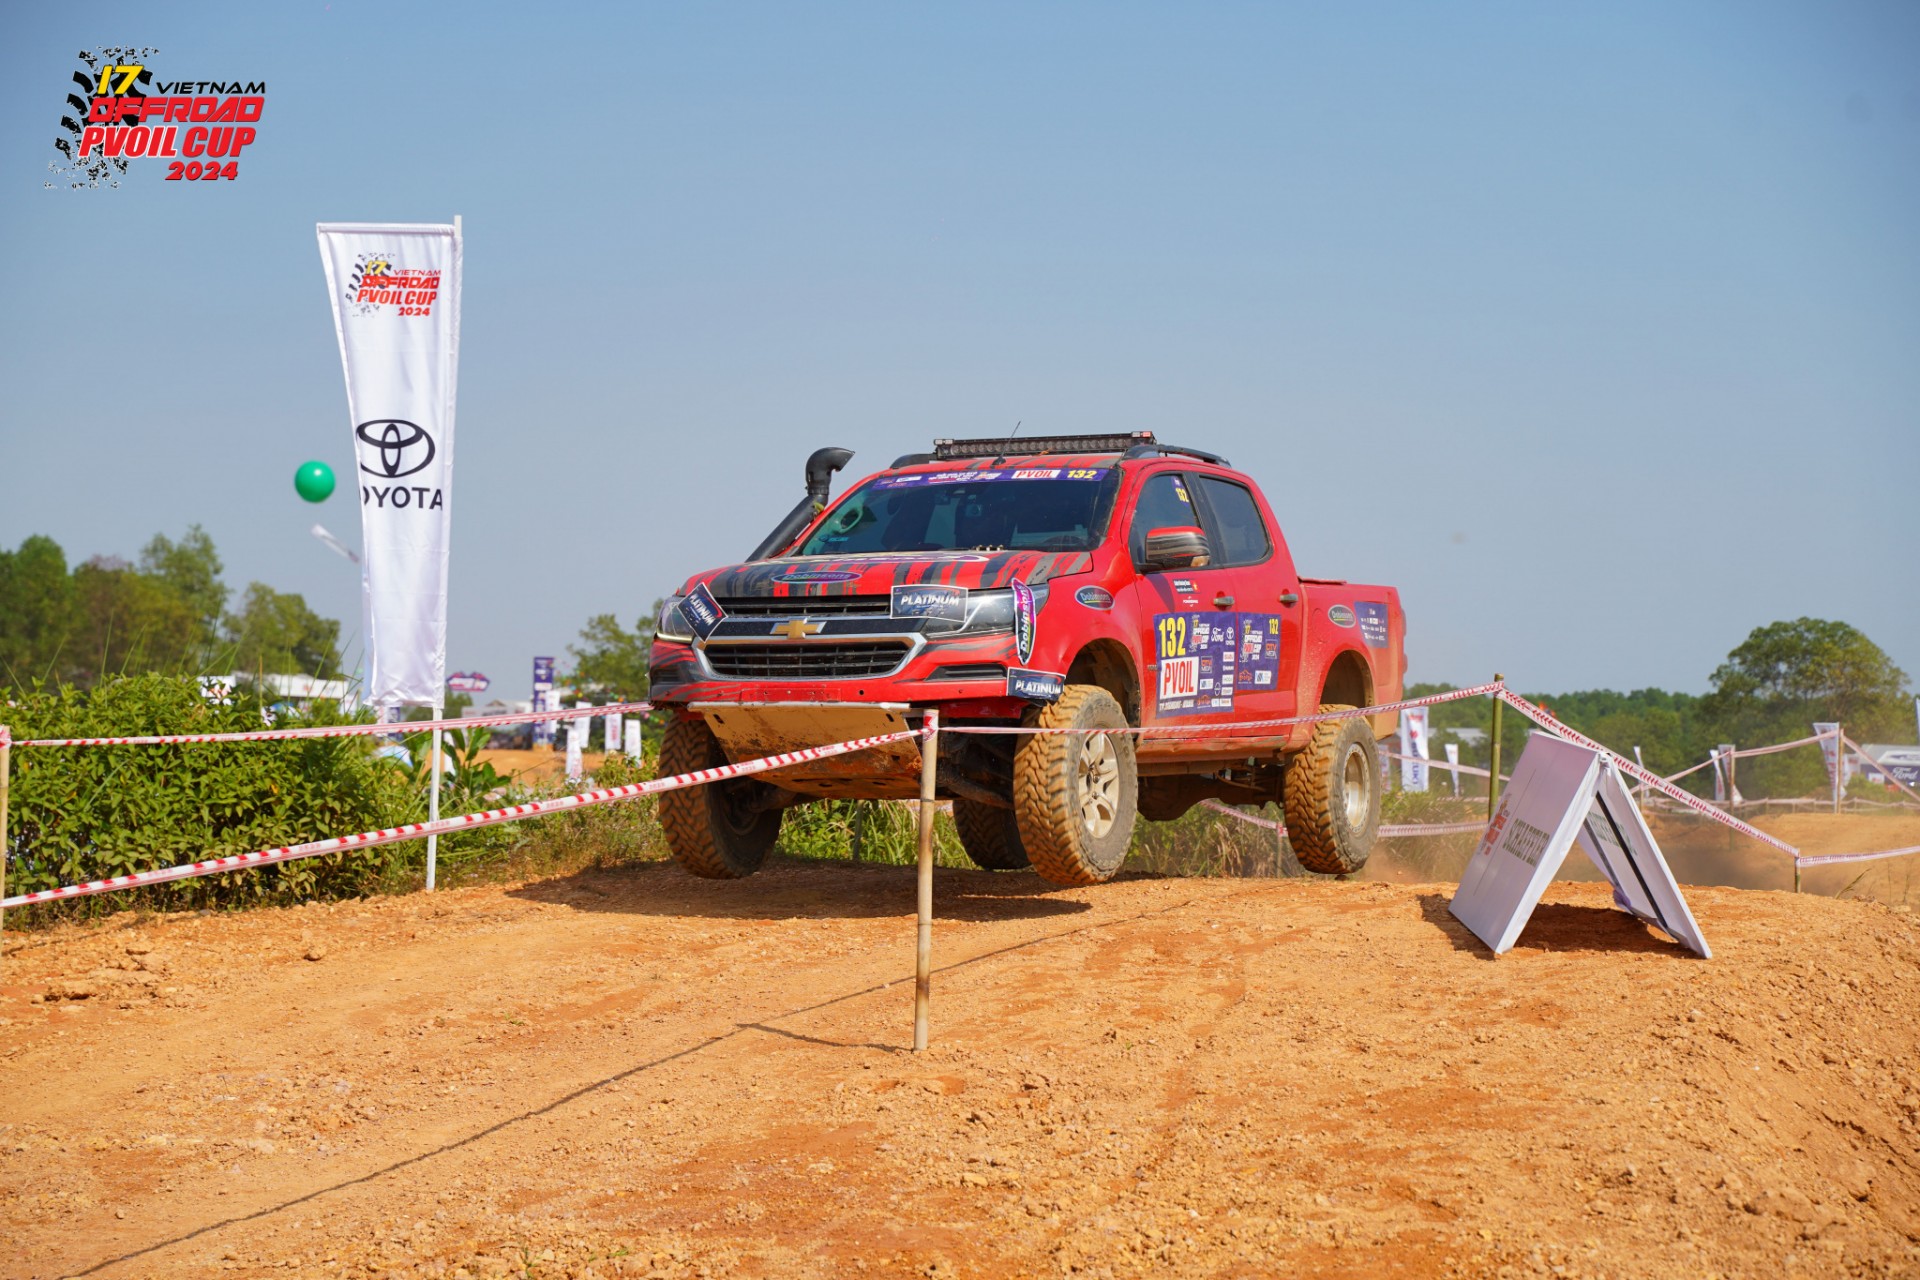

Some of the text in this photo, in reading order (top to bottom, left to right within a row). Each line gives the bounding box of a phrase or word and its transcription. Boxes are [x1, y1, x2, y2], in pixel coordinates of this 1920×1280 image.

[366, 260, 388, 275] 17
[362, 275, 440, 289] OFFROAD
[357, 289, 437, 306] PVOIL CUP
[398, 307, 430, 316] 2024
[1016, 469, 1098, 479] PVOIL 132
[900, 594, 959, 607] PLATINUM
[689, 593, 717, 627] PLATINUM
[1268, 618, 1279, 635] 132
[1159, 616, 1186, 658] 132
[1211, 627, 1224, 642] Ford
[1163, 660, 1194, 696] PVOIL
[1015, 680, 1061, 695] PLATINUM
[1892, 766, 1919, 781] Ford
